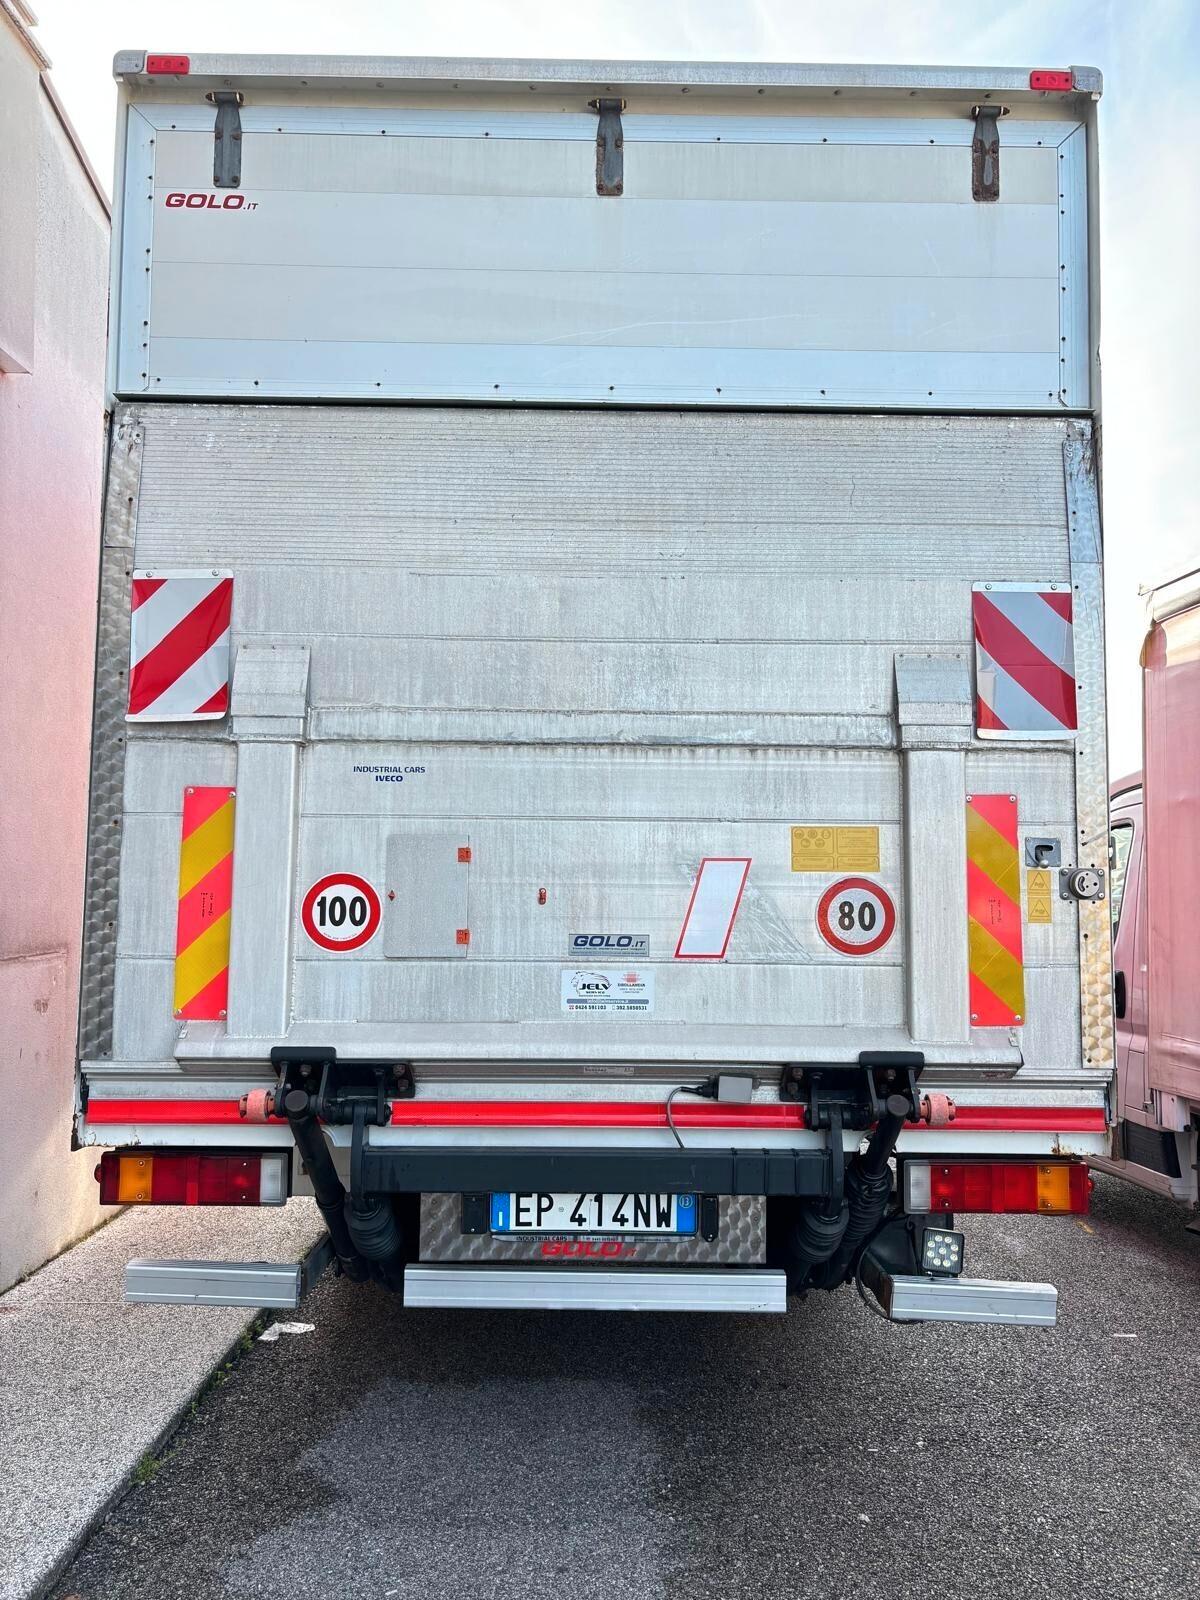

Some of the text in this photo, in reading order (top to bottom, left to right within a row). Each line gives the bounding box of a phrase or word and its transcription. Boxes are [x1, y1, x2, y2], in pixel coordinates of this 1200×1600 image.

[165, 193, 259, 210] GOLO.IT
[353, 765, 403, 773] INDUSTRIAL
[316, 895, 367, 927] 100
[838, 900, 876, 931] 80
[579, 983, 612, 991] JELV
[515, 1193, 673, 1228] EP 414NW
